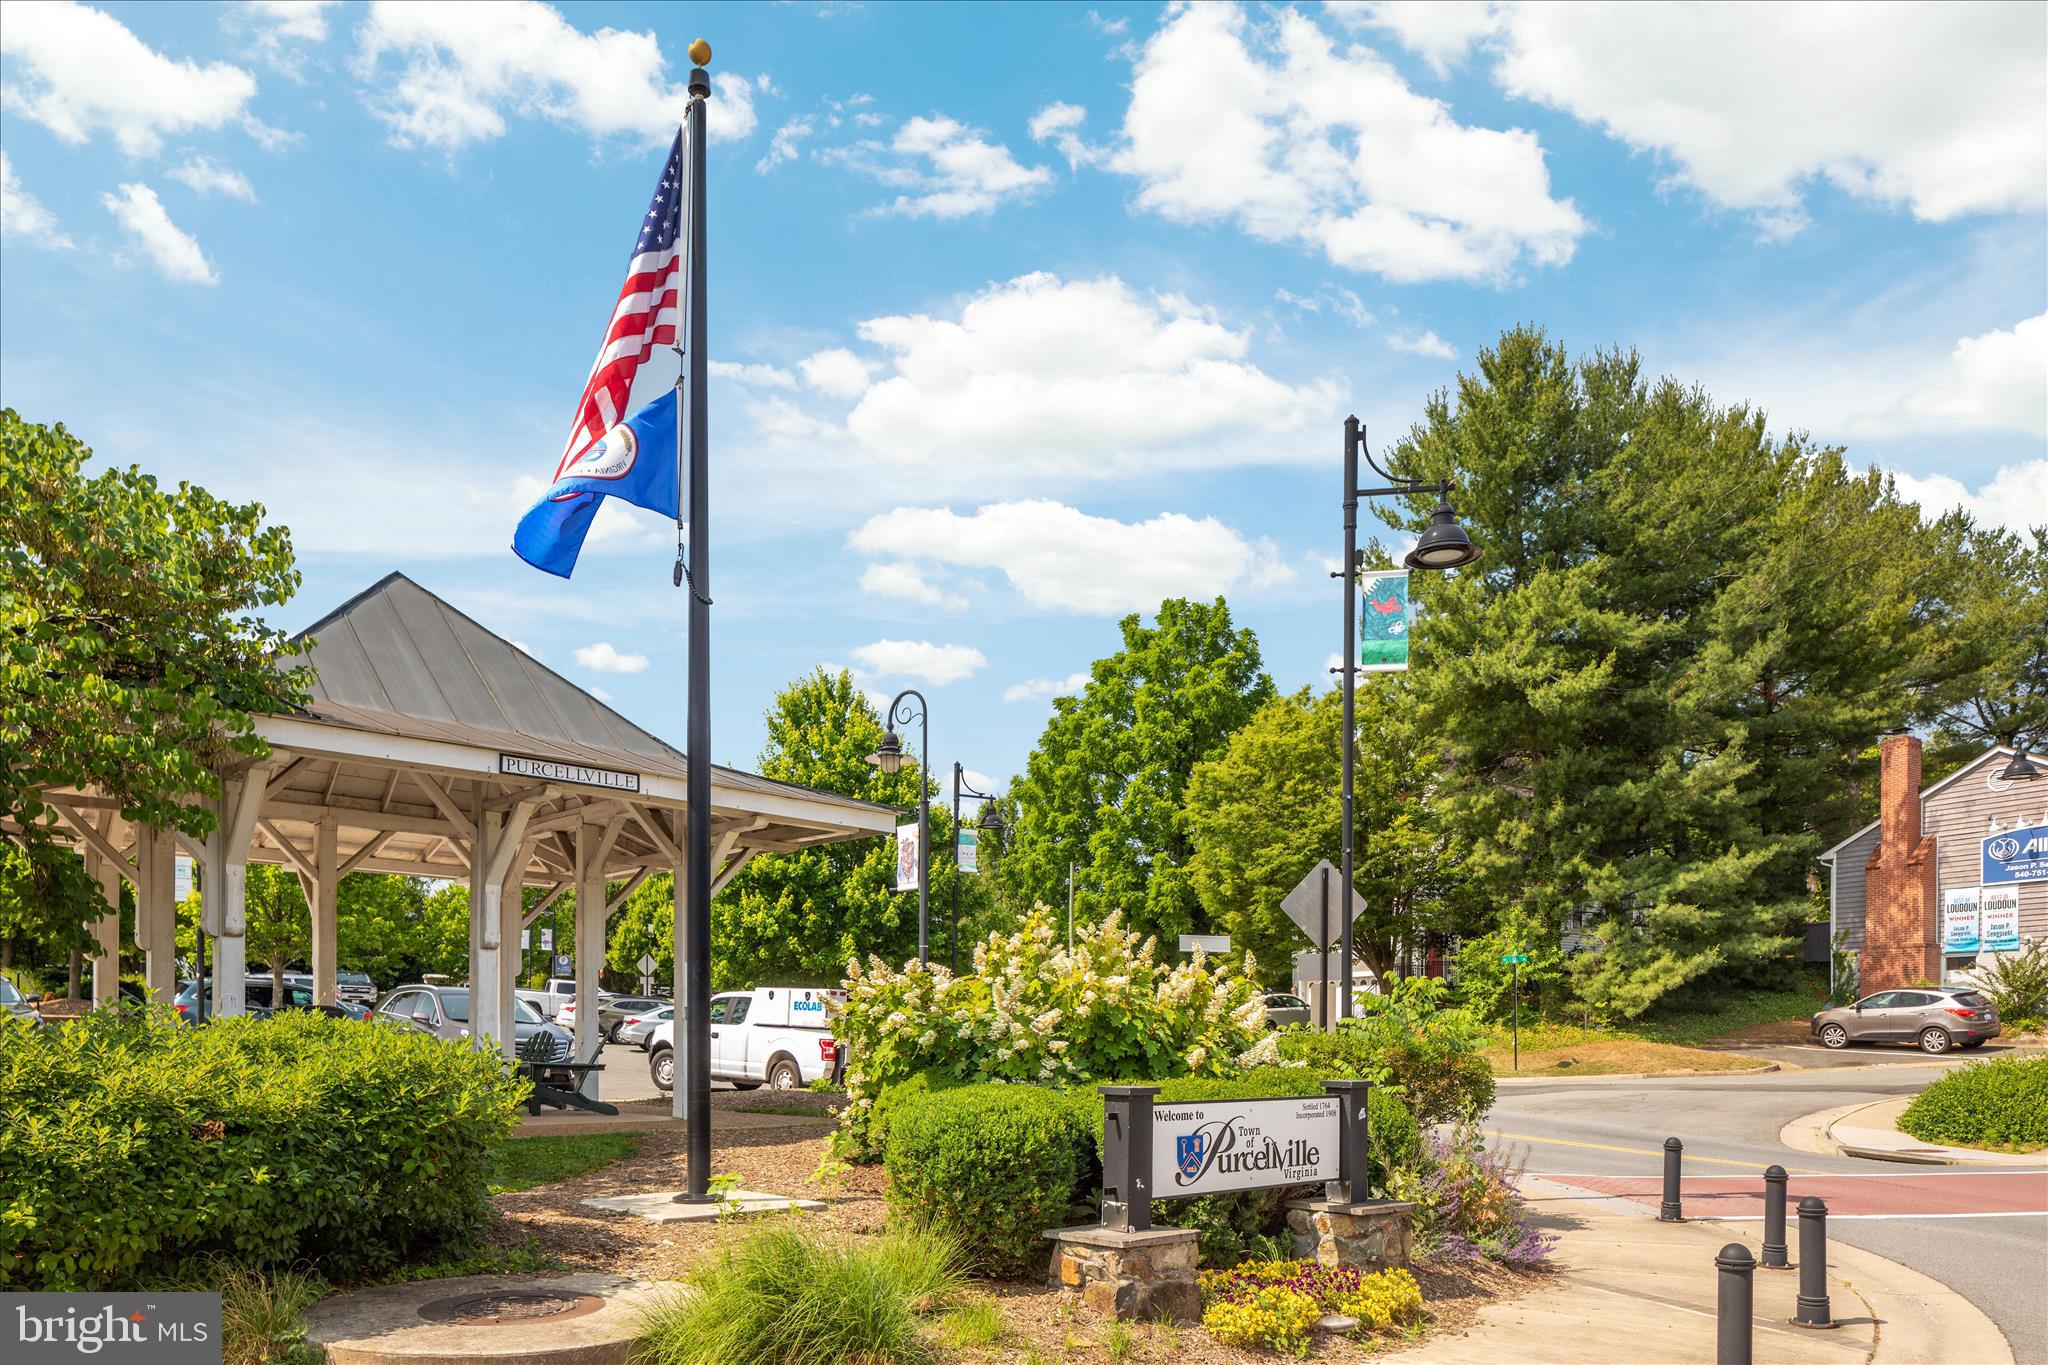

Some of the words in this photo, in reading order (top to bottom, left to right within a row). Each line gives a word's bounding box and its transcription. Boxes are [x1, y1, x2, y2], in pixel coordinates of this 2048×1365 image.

[506, 758, 634, 788] PURCELLVILLE
[1947, 903, 1978, 913] LOUDOUN
[1984, 899, 2017, 910] LOUDOUN
[794, 1001, 822, 1011] ECOLAB
[1302, 1102, 1319, 1111] Settled
[1154, 1110, 1193, 1122] Welcome
[1195, 1110, 1204, 1120] to
[1296, 1110, 1325, 1120] Incorporated
[1325, 1109, 1337, 1118] 1908
[1238, 1126, 1261, 1137] Town
[1246, 1137, 1255, 1149] of
[1283, 1167, 1318, 1181] Virginia
